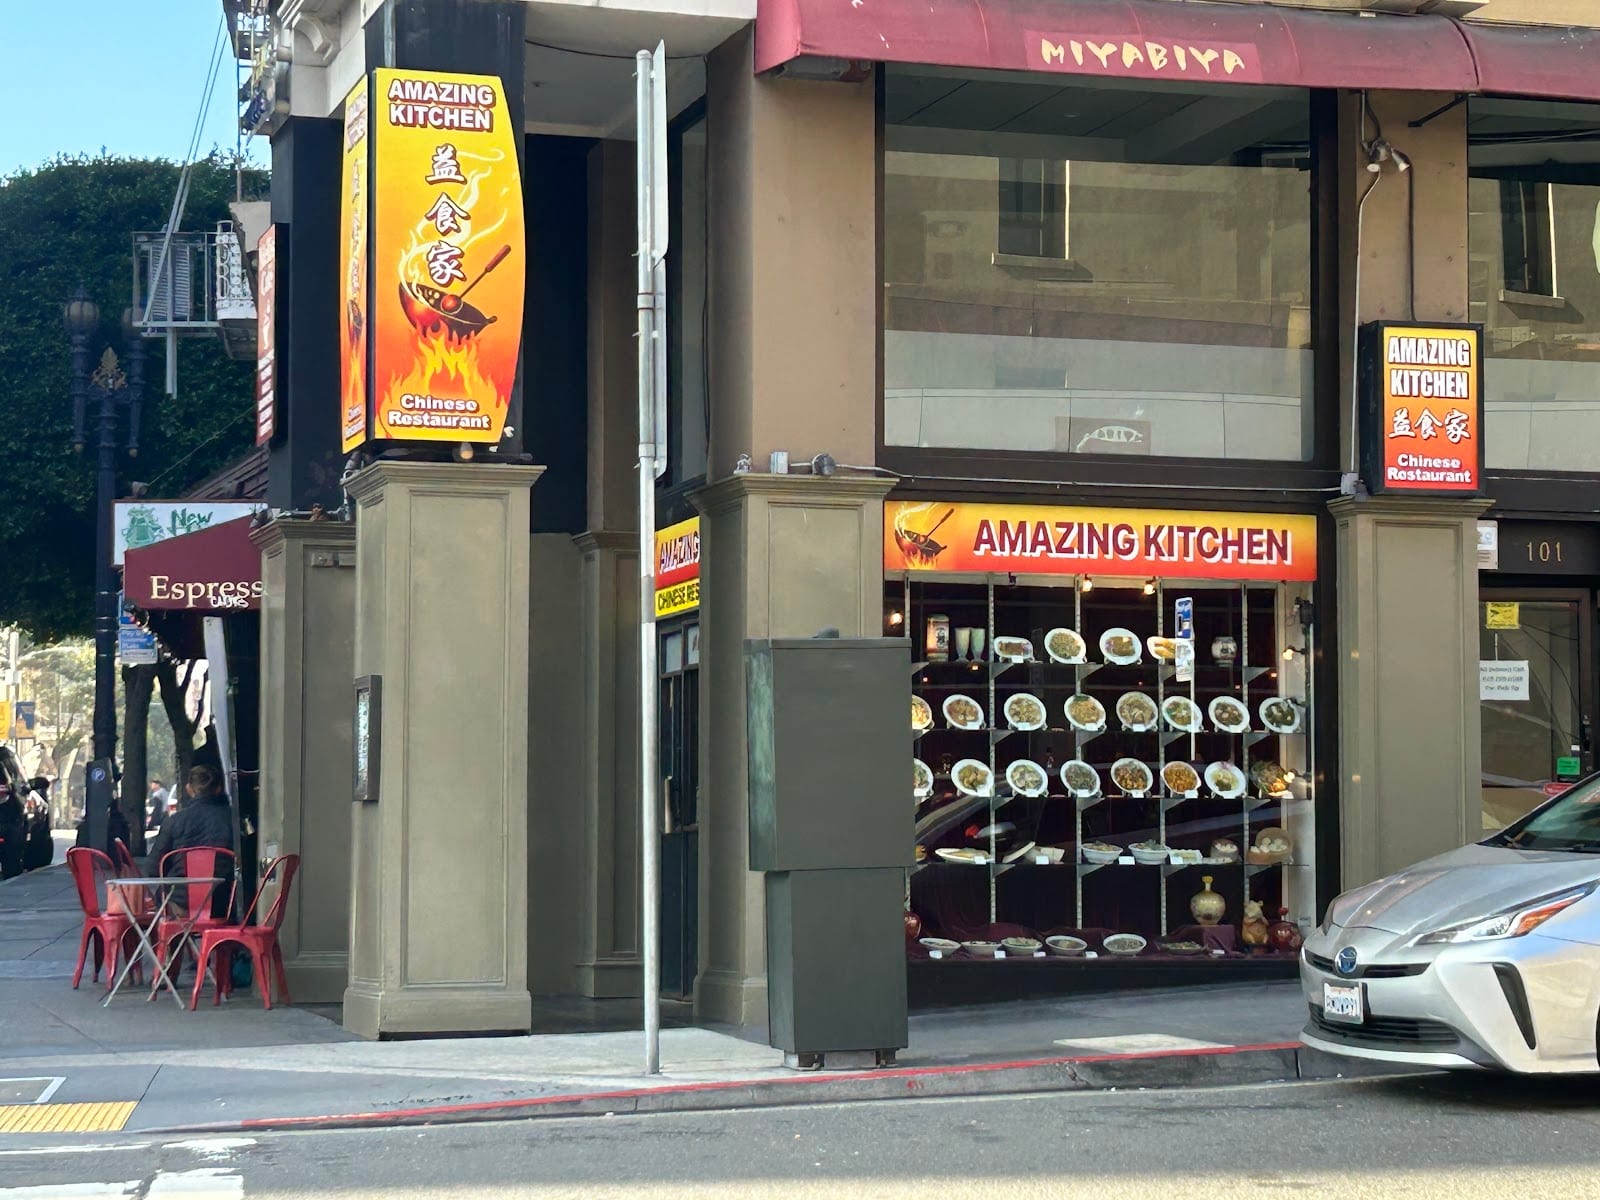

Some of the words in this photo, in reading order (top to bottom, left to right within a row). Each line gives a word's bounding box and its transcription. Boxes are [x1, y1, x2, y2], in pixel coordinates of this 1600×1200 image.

[1041, 38, 1246, 75] MIYABIYA
[388, 79, 495, 107] AMAZING
[389, 103, 494, 131] KITCHEN
[425, 143, 471, 287] 益食家
[1387, 336, 1470, 366] AMAZING
[1390, 368, 1469, 399] KITCHEN
[400, 394, 479, 414] Chinese
[388, 411, 491, 430] Restaurant
[1388, 408, 1471, 444] 益食家
[1387, 468, 1471, 483] Restaurant
[1397, 453, 1461, 469] Chinese
[167, 508, 213, 533] New
[659, 531, 700, 574] AMAZING
[973, 519, 1138, 561] AMAZING
[1144, 524, 1294, 566] KITCHEN
[1527, 541, 1563, 562] 101
[150, 575, 263, 608] Espress
